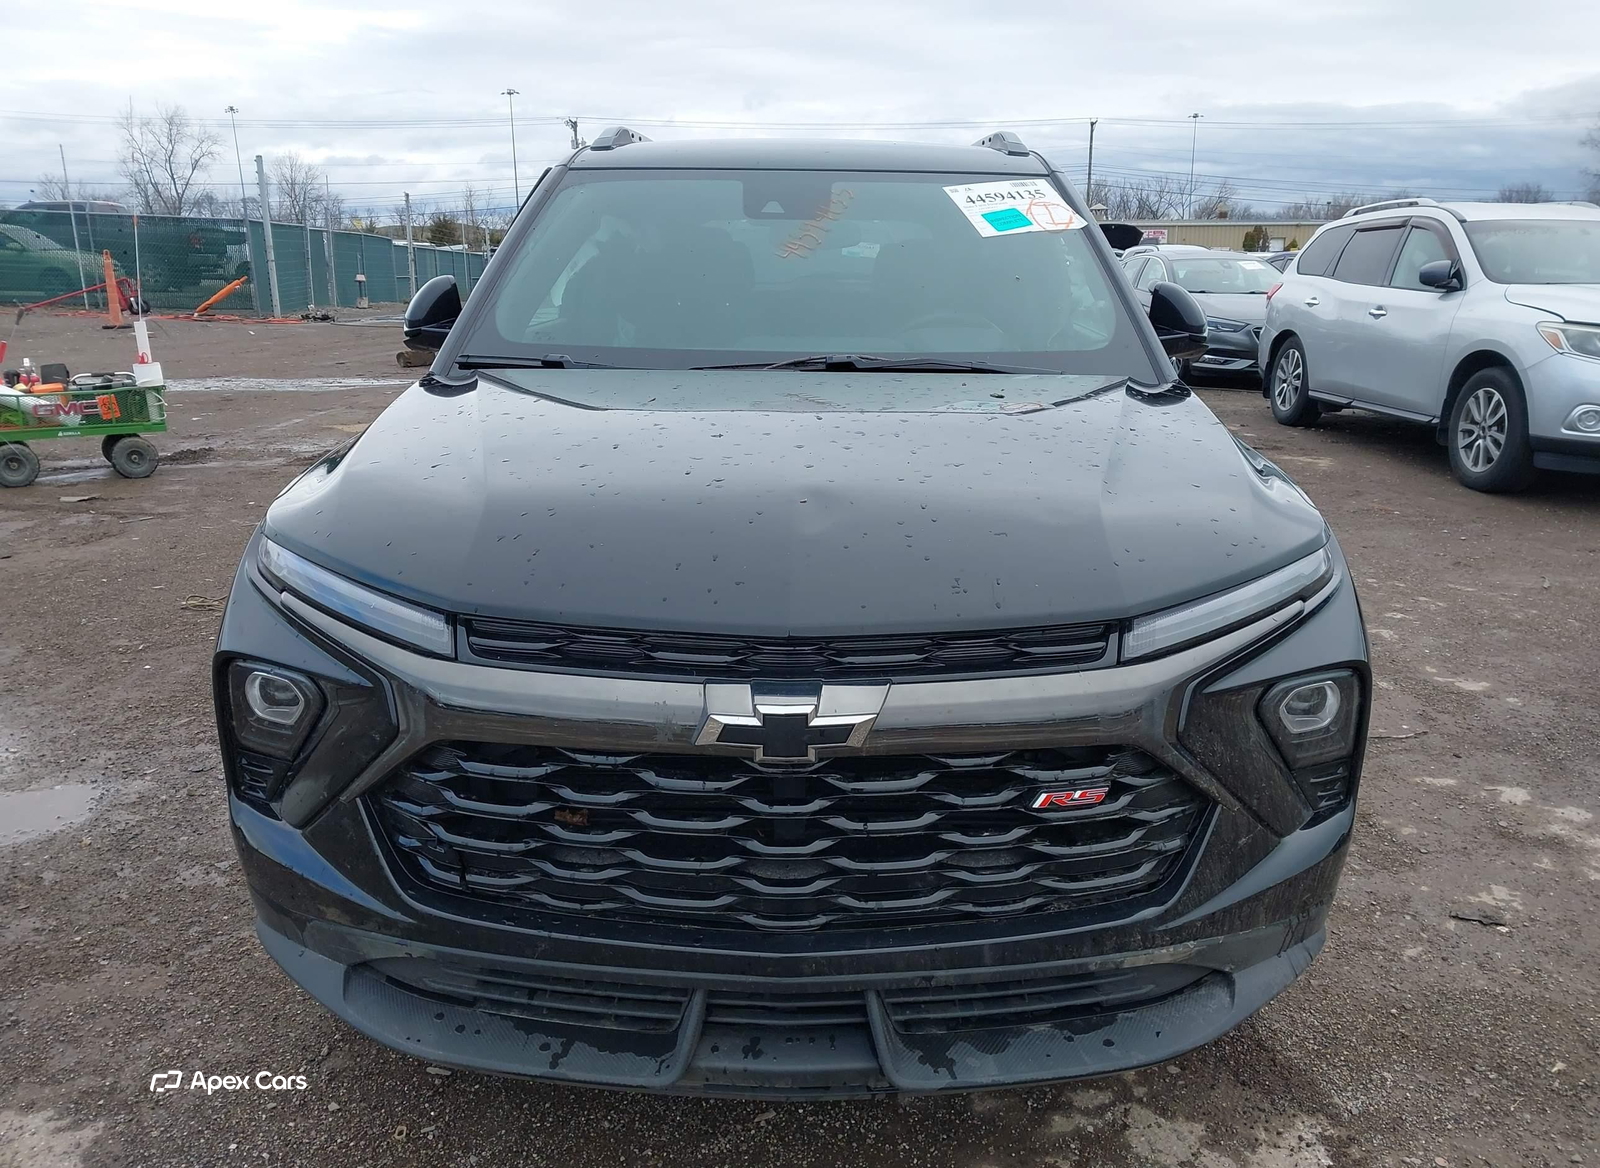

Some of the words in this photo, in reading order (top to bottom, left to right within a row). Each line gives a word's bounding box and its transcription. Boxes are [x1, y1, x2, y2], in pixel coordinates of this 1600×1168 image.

[965, 189, 1046, 204] 44594135
[33, 401, 100, 417] GMC
[1032, 787, 1109, 808] RS
